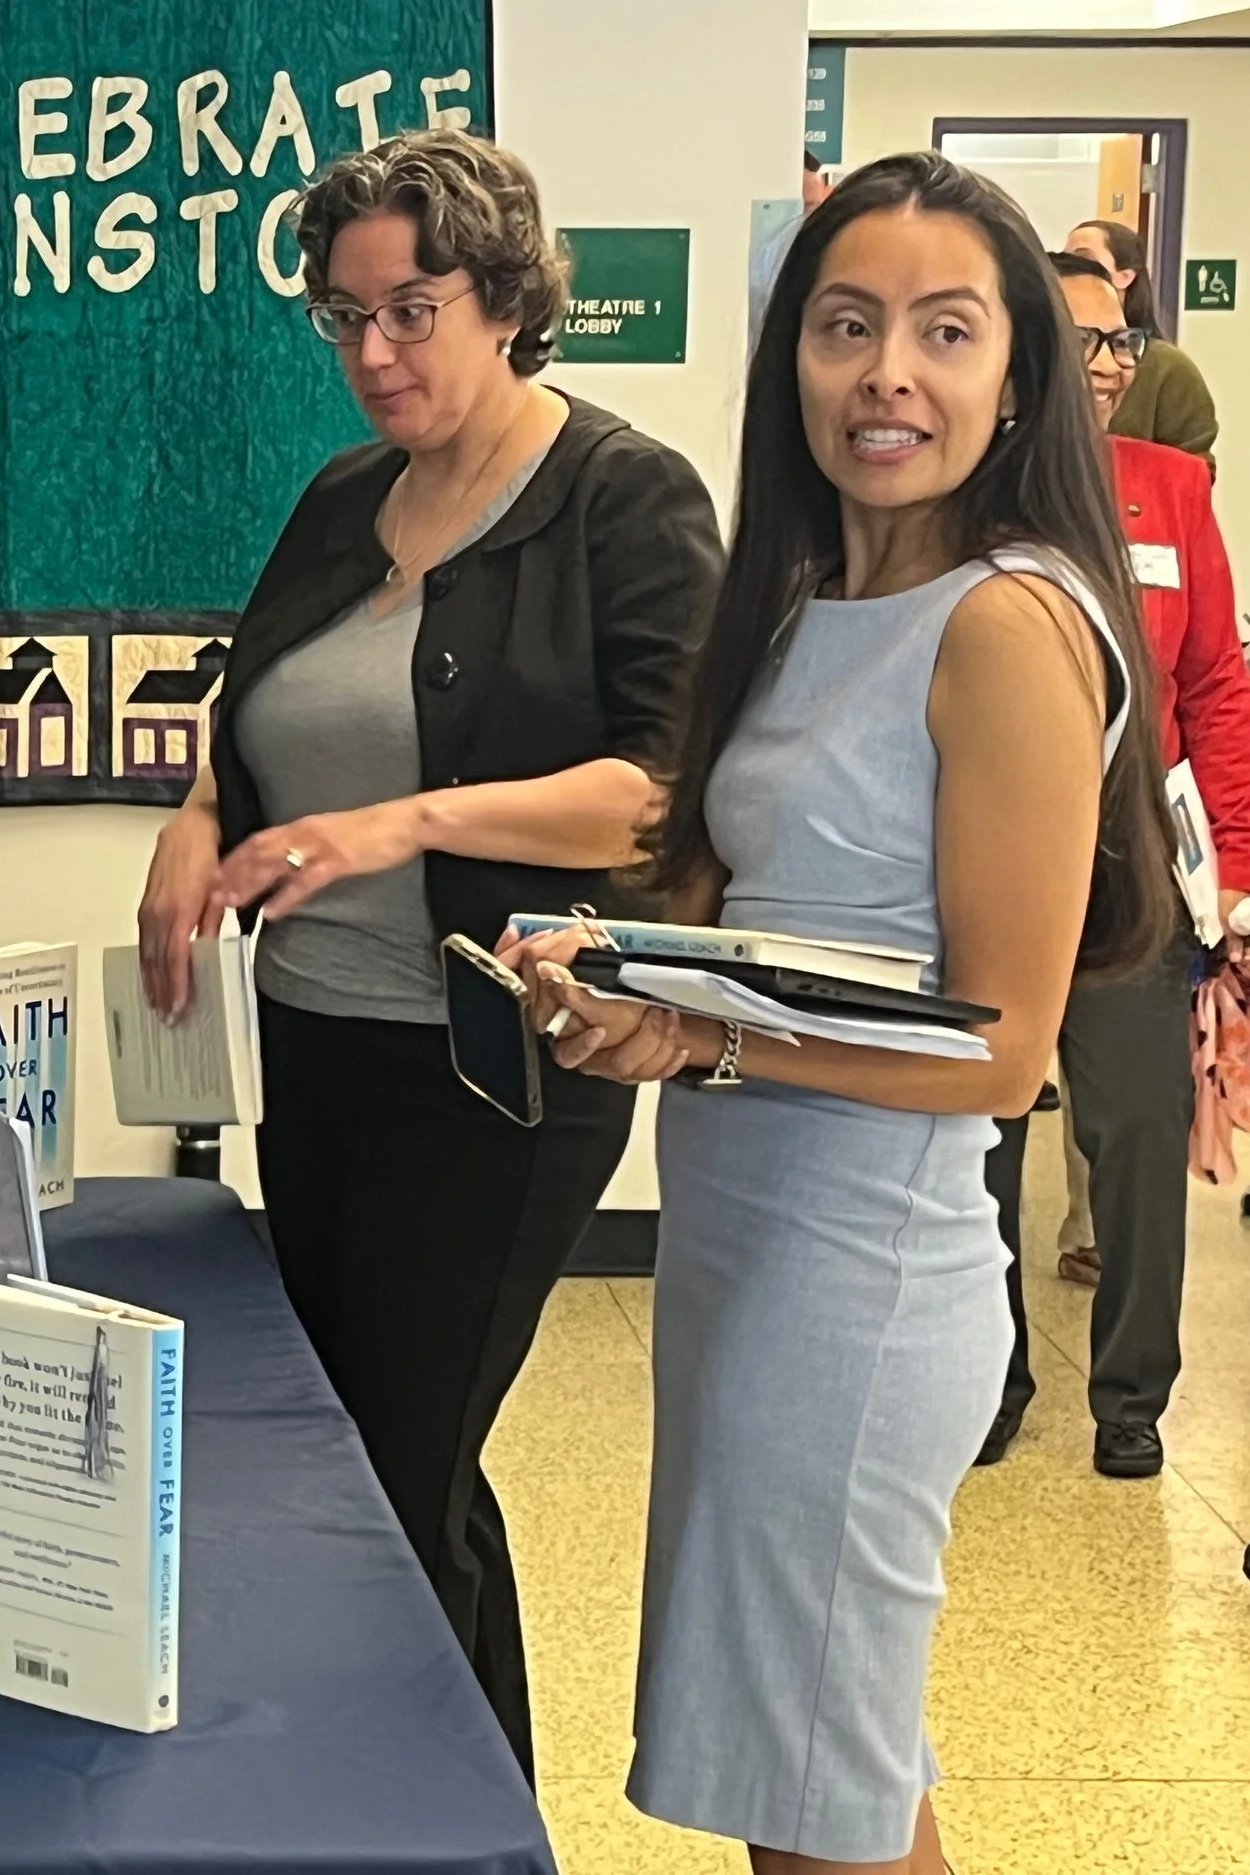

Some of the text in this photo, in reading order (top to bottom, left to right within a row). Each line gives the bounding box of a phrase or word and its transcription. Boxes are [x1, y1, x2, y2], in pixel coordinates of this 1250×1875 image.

[567, 299, 662, 315] THEATRE 1
[565, 318, 623, 334] LOBBY
[38, 1179, 65, 1197] ACH
[159, 1348, 177, 1417] FAITH
[61, 1407, 82, 1424] the
[162, 1426, 174, 1468] OVER
[158, 1478, 176, 1538] FEAR
